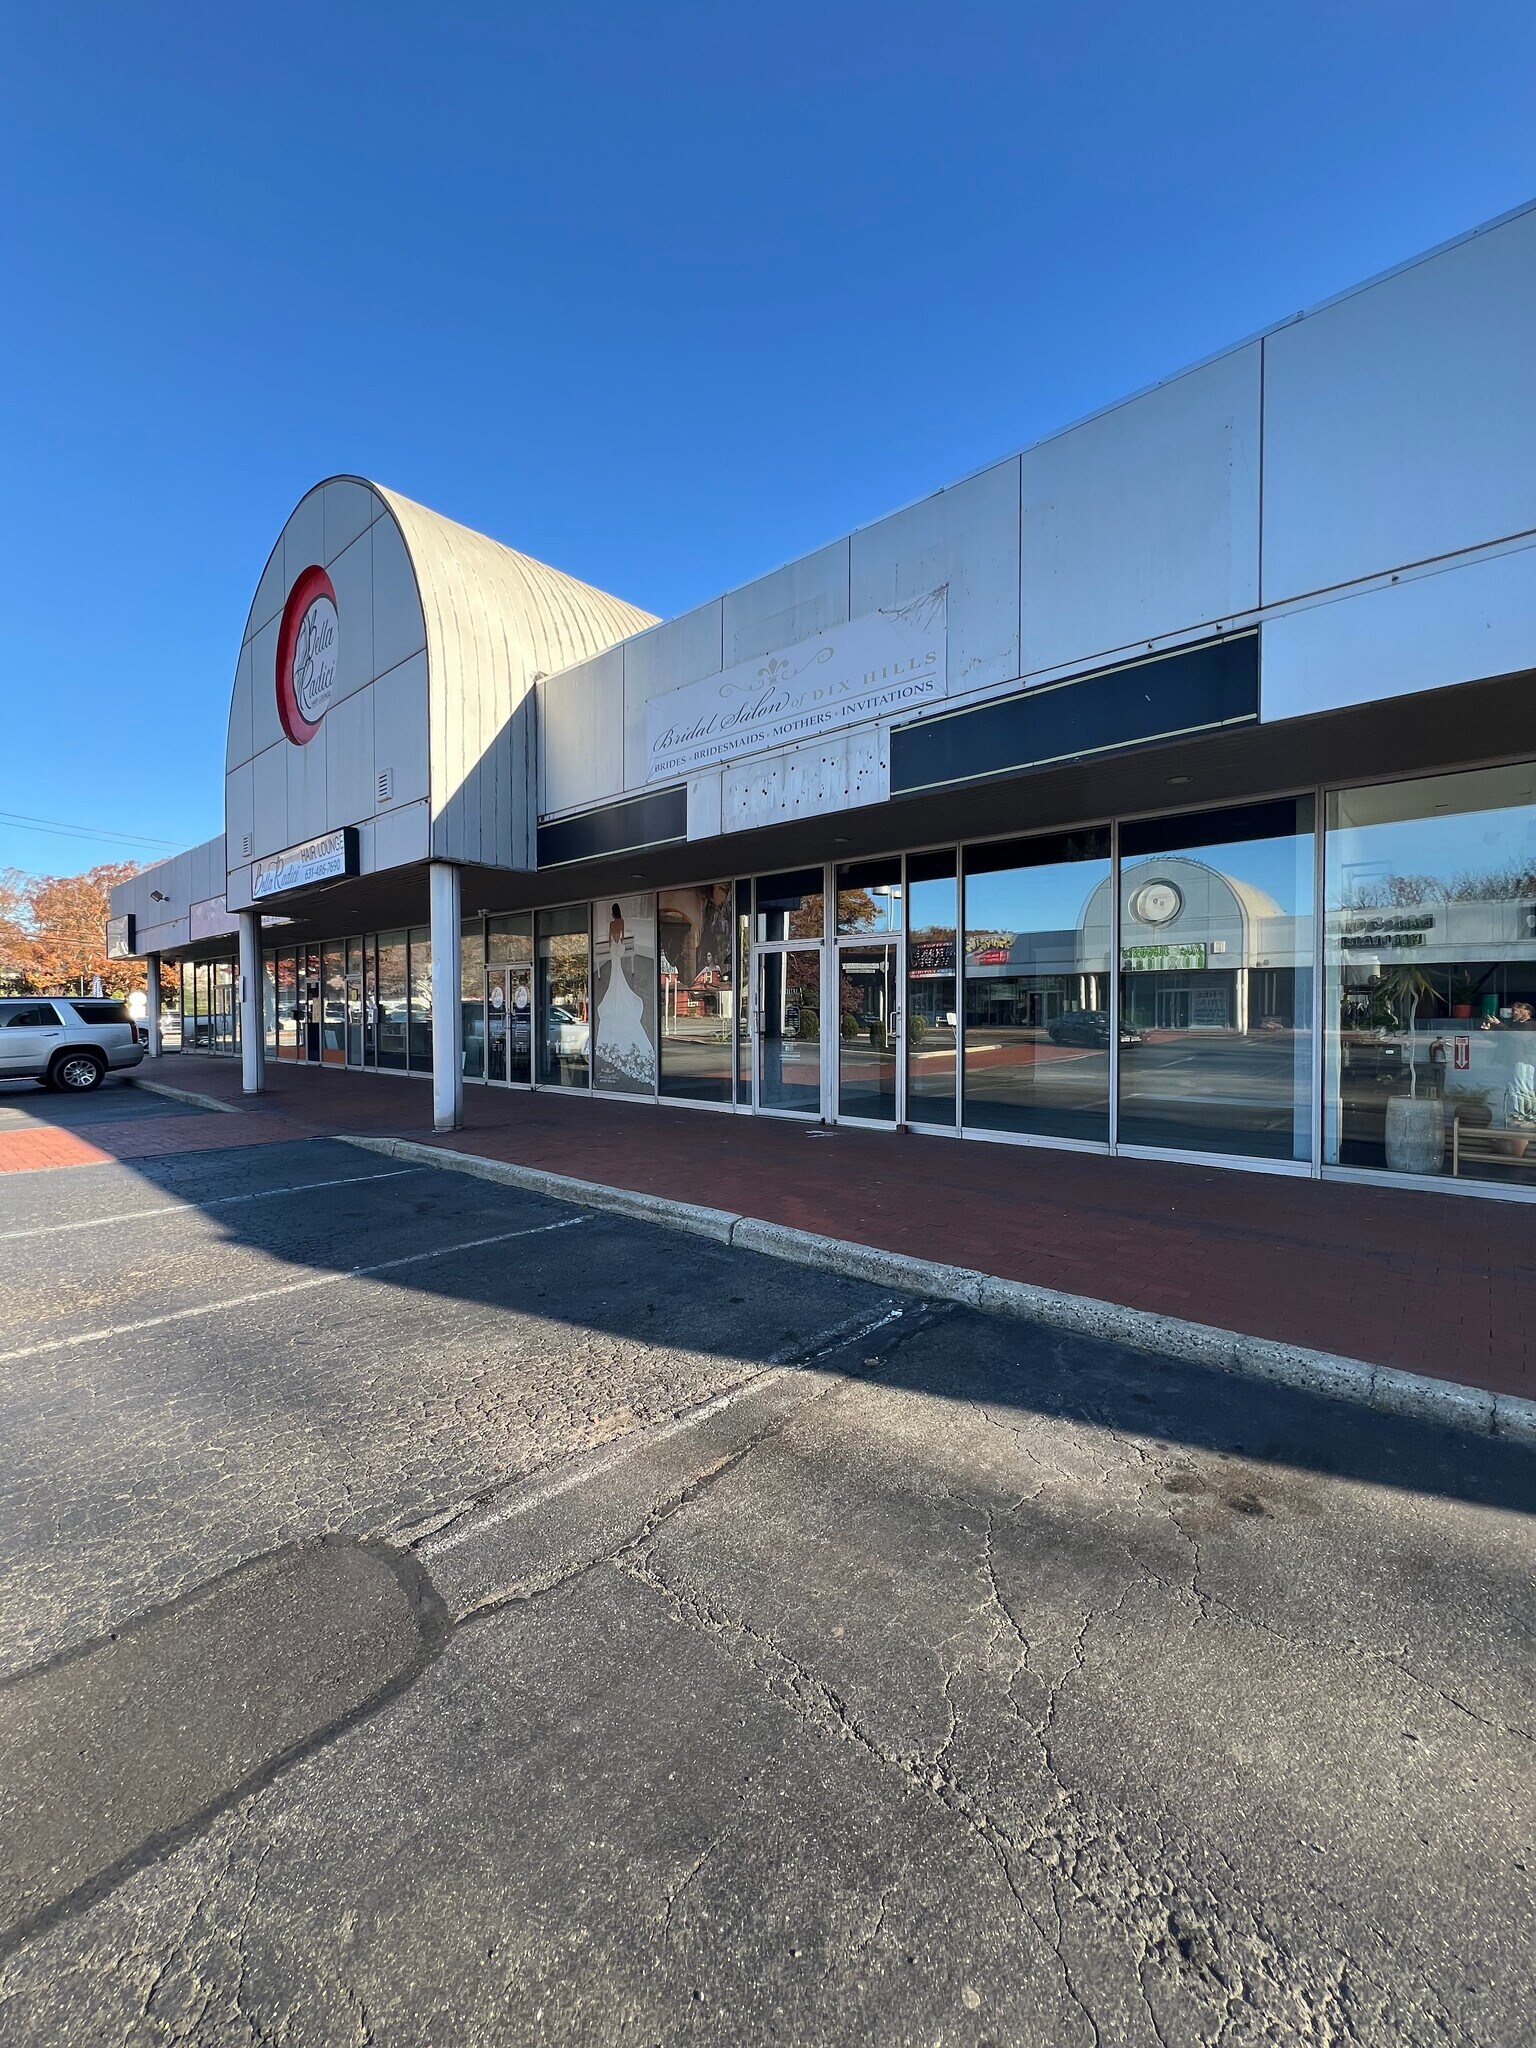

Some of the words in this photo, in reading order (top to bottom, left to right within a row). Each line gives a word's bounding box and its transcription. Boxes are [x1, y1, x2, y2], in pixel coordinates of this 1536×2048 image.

[304, 608, 334, 657] Bella
[294, 659, 335, 710] Radici
[652, 713, 718, 752] Bridal
[720, 686, 790, 733] Salon
[791, 692, 807, 709] of
[812, 679, 850, 701] DIX
[863, 650, 937, 685] HILLS
[654, 757, 687, 773] BRIDES
[694, 731, 765, 760] BRIDESMAIDS
[773, 711, 832, 737] MOTHERS
[842, 680, 934, 716] INVITATIONS
[268, 856, 300, 890] Radici
[300, 845, 317, 863] HAIR
[318, 834, 344, 858] LOUNGE
[304, 859, 341, 881] 631-486-7690
